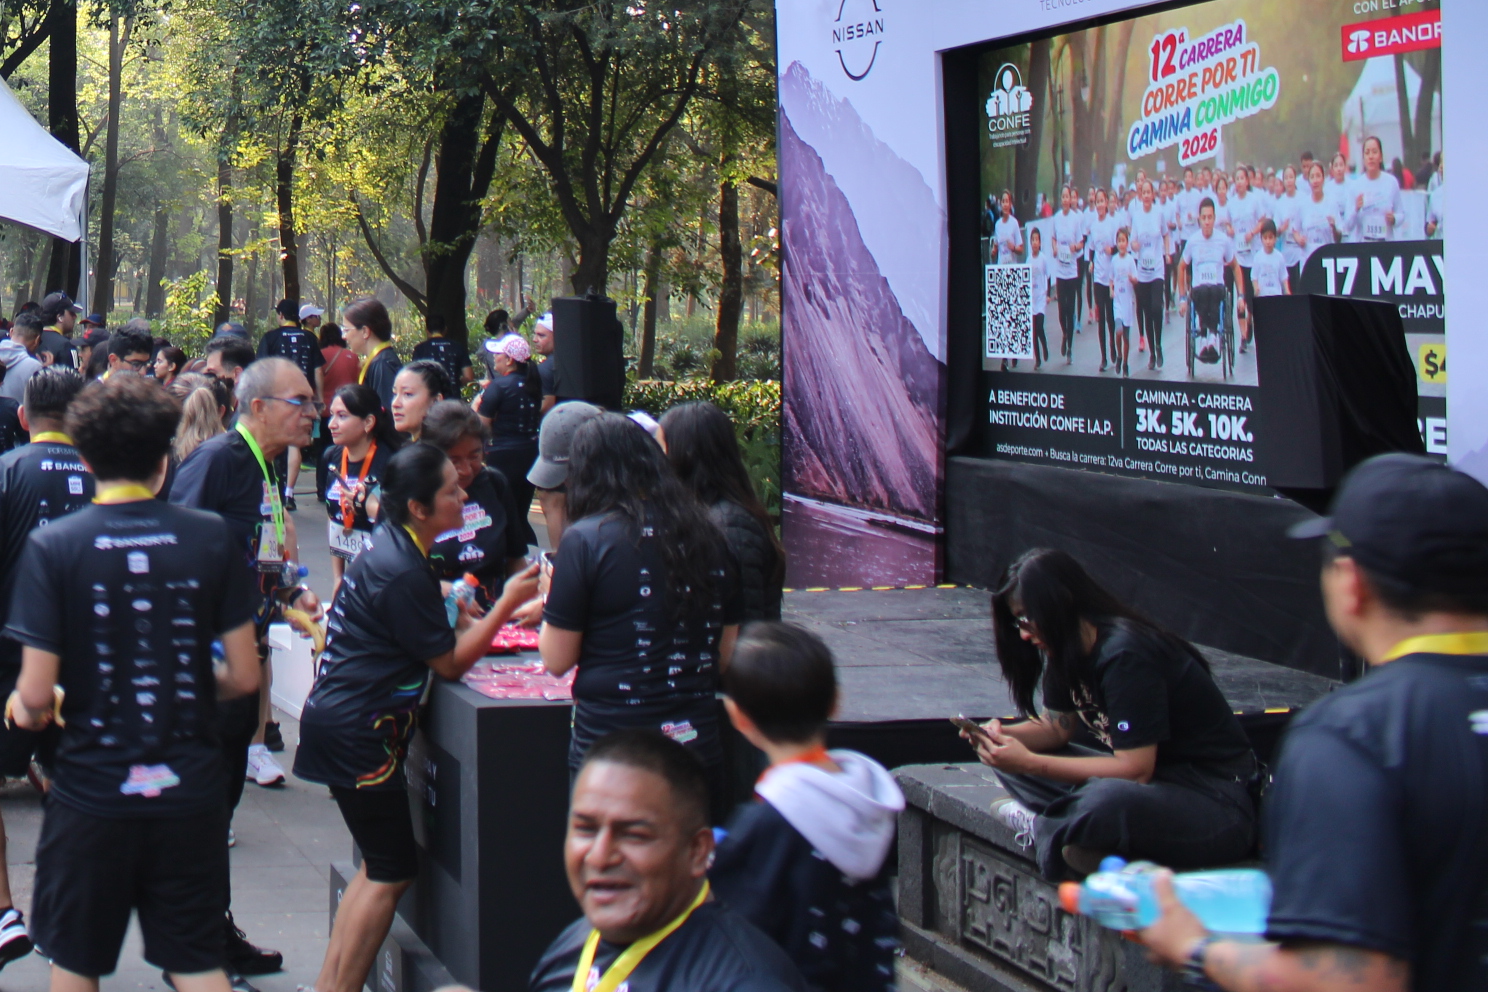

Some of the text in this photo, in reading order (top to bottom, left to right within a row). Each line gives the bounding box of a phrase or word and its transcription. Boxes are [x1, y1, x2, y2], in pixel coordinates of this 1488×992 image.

[832, 18, 884, 44] NISSAN
[1178, 24, 1243, 71] CARRERA
[1143, 47, 1257, 118] CORRE POR TI
[988, 113, 1030, 132] CONFE
[1129, 73, 1277, 154] CAMINA CONMIGO
[1181, 127, 1218, 160] 2026
[1321, 256, 1359, 296] 17
[989, 388, 1065, 410] A BENEFICIO DE
[1135, 389, 1253, 412] CAMINATA CARRERA
[989, 409, 1114, 437] INSTITUCIÓN CONFE I.A.P.
[1135, 408, 1253, 443] 3K. 5K. 10K.
[996, 442, 1044, 458] asdeporte.com
[1049, 448, 1071, 463] Busca
[1071, 451, 1079, 463] la
[1079, 454, 1107, 467] carrera:
[1107, 454, 1124, 469] 12va
[1124, 457, 1153, 473] Carrera
[1154, 461, 1178, 476] Corre
[1178, 465, 1194, 479] por
[1204, 467, 1240, 483] Camina
[1136, 437, 1253, 462] TODAS LAS CATEGORIAS
[110, 533, 179, 549] BANORTE
